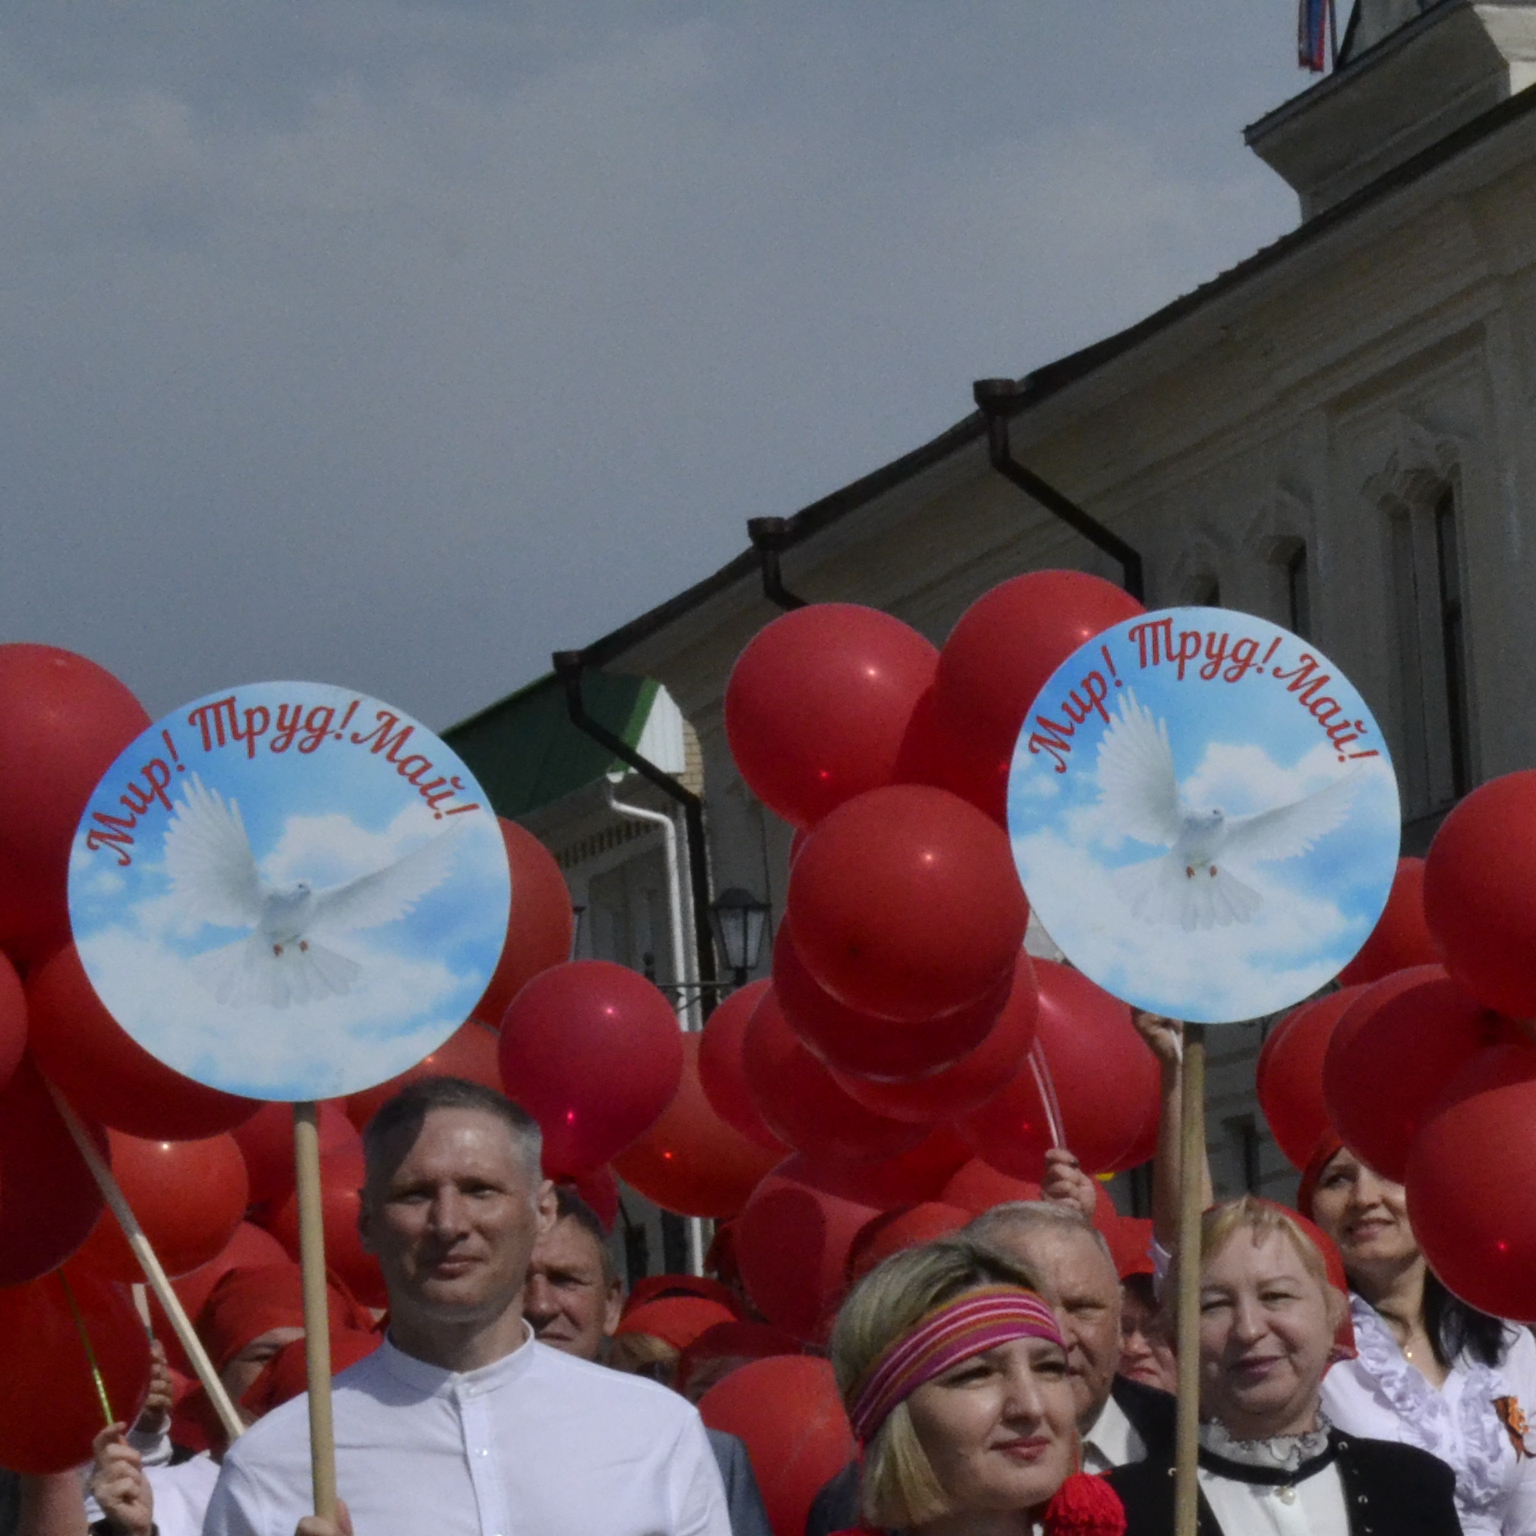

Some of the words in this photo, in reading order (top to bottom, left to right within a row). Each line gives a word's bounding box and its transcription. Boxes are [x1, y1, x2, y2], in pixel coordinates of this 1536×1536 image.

[1028, 645, 1124, 774] Мир!
[1128, 617, 1283, 682] Труд!
[1273, 653, 1379, 763] Май!
[86, 729, 185, 866] Мир!
[187, 696, 360, 760] Труд!
[351, 710, 480, 820] Май!
